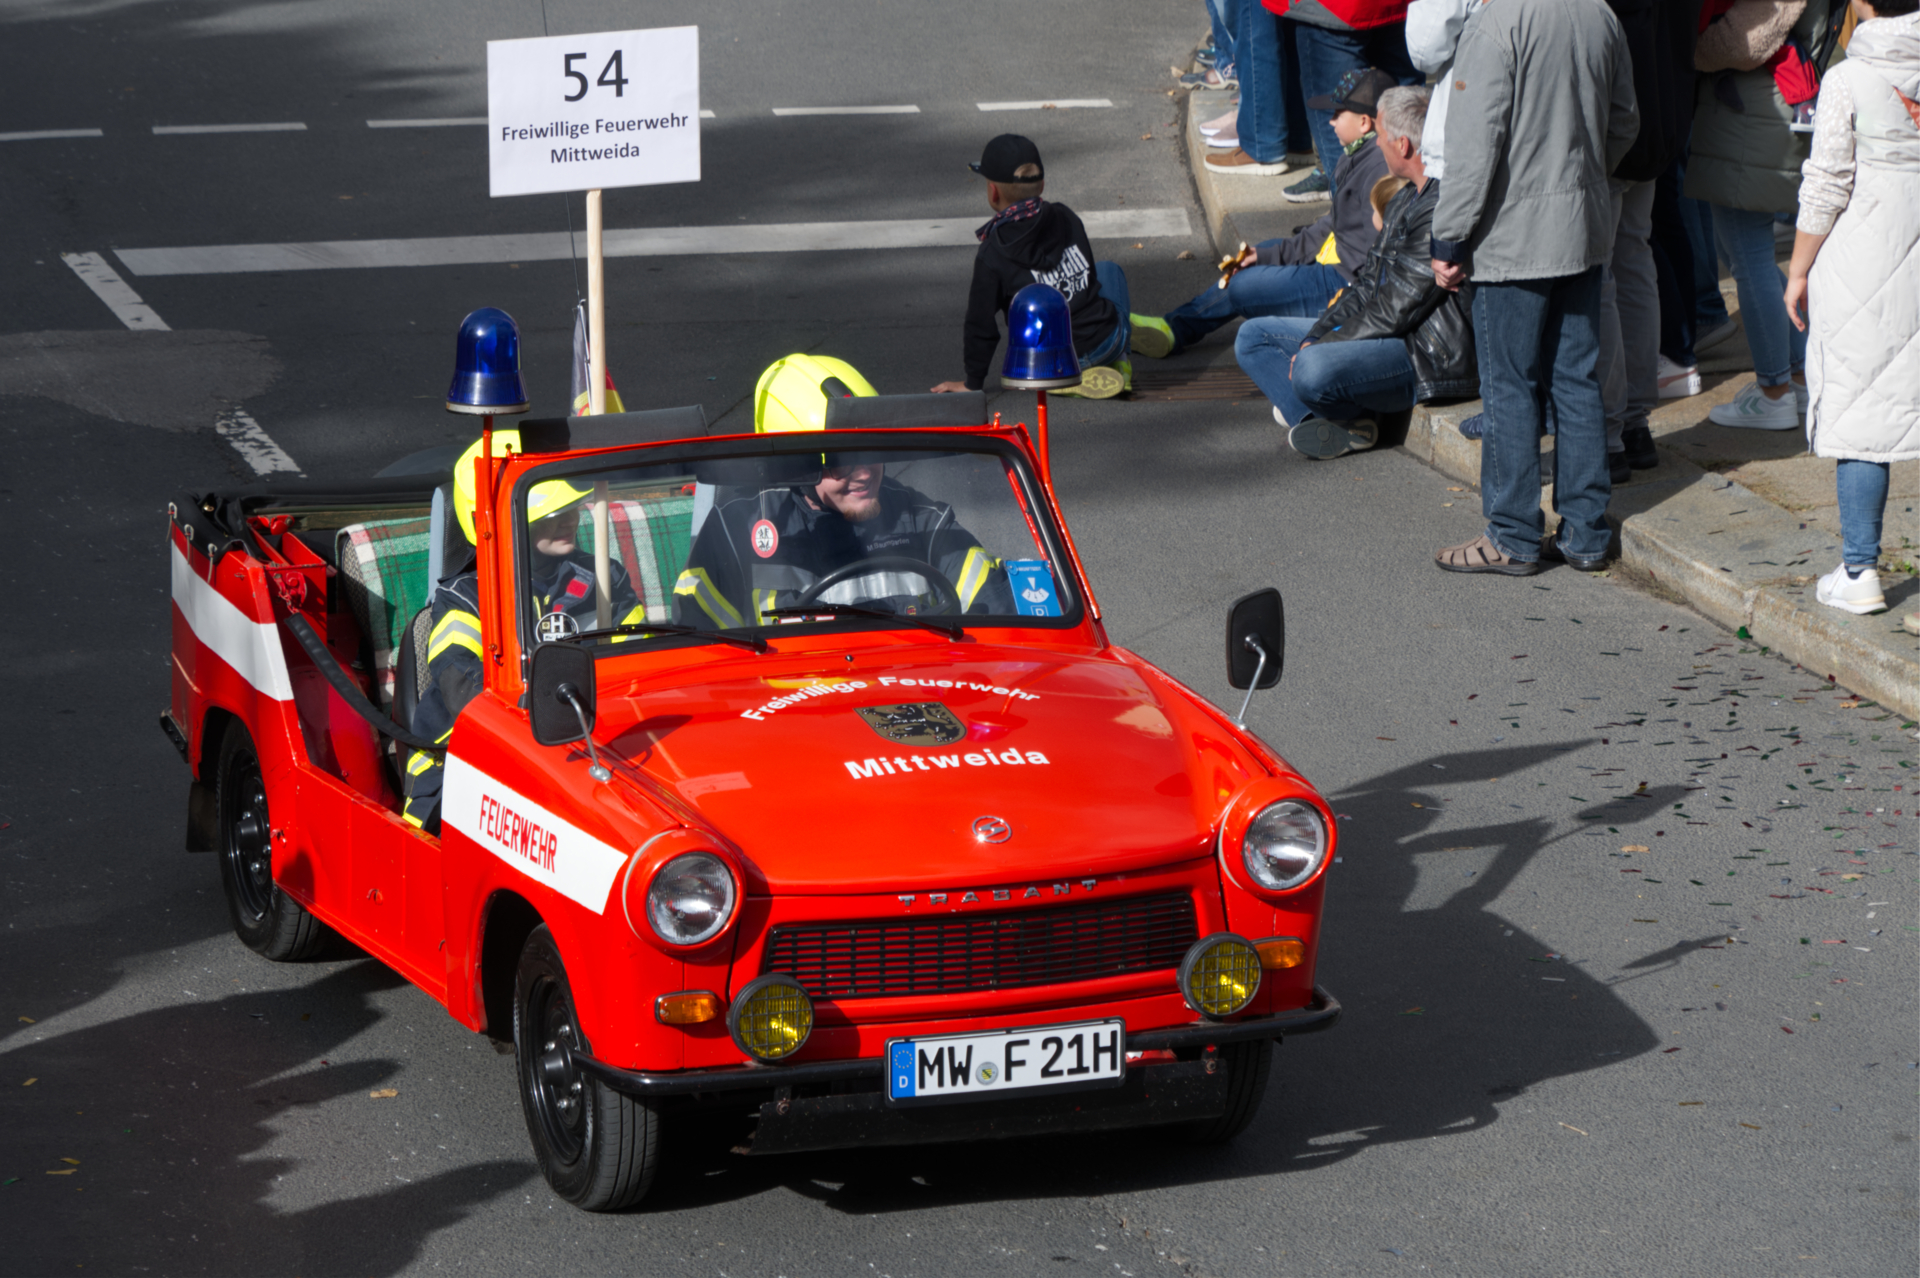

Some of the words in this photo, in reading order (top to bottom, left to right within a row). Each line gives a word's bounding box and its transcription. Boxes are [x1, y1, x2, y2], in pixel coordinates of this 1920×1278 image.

[564, 49, 629, 102] 54
[502, 121, 590, 141] Freiwillige
[595, 112, 689, 134] Feuerwehr
[550, 142, 640, 163] Mittweida
[550, 615, 564, 633] H
[740, 680, 868, 721] Freiwillige
[877, 676, 1041, 701] Feuerwehr
[844, 747, 1050, 780] Mittweida
[479, 793, 557, 873] FEUERWEHR
[898, 879, 1096, 906] TRABANT
[918, 1044, 973, 1089] MW
[1005, 1039, 1030, 1082] F
[1040, 1030, 1118, 1079] 21H
[899, 1076, 909, 1088] D
